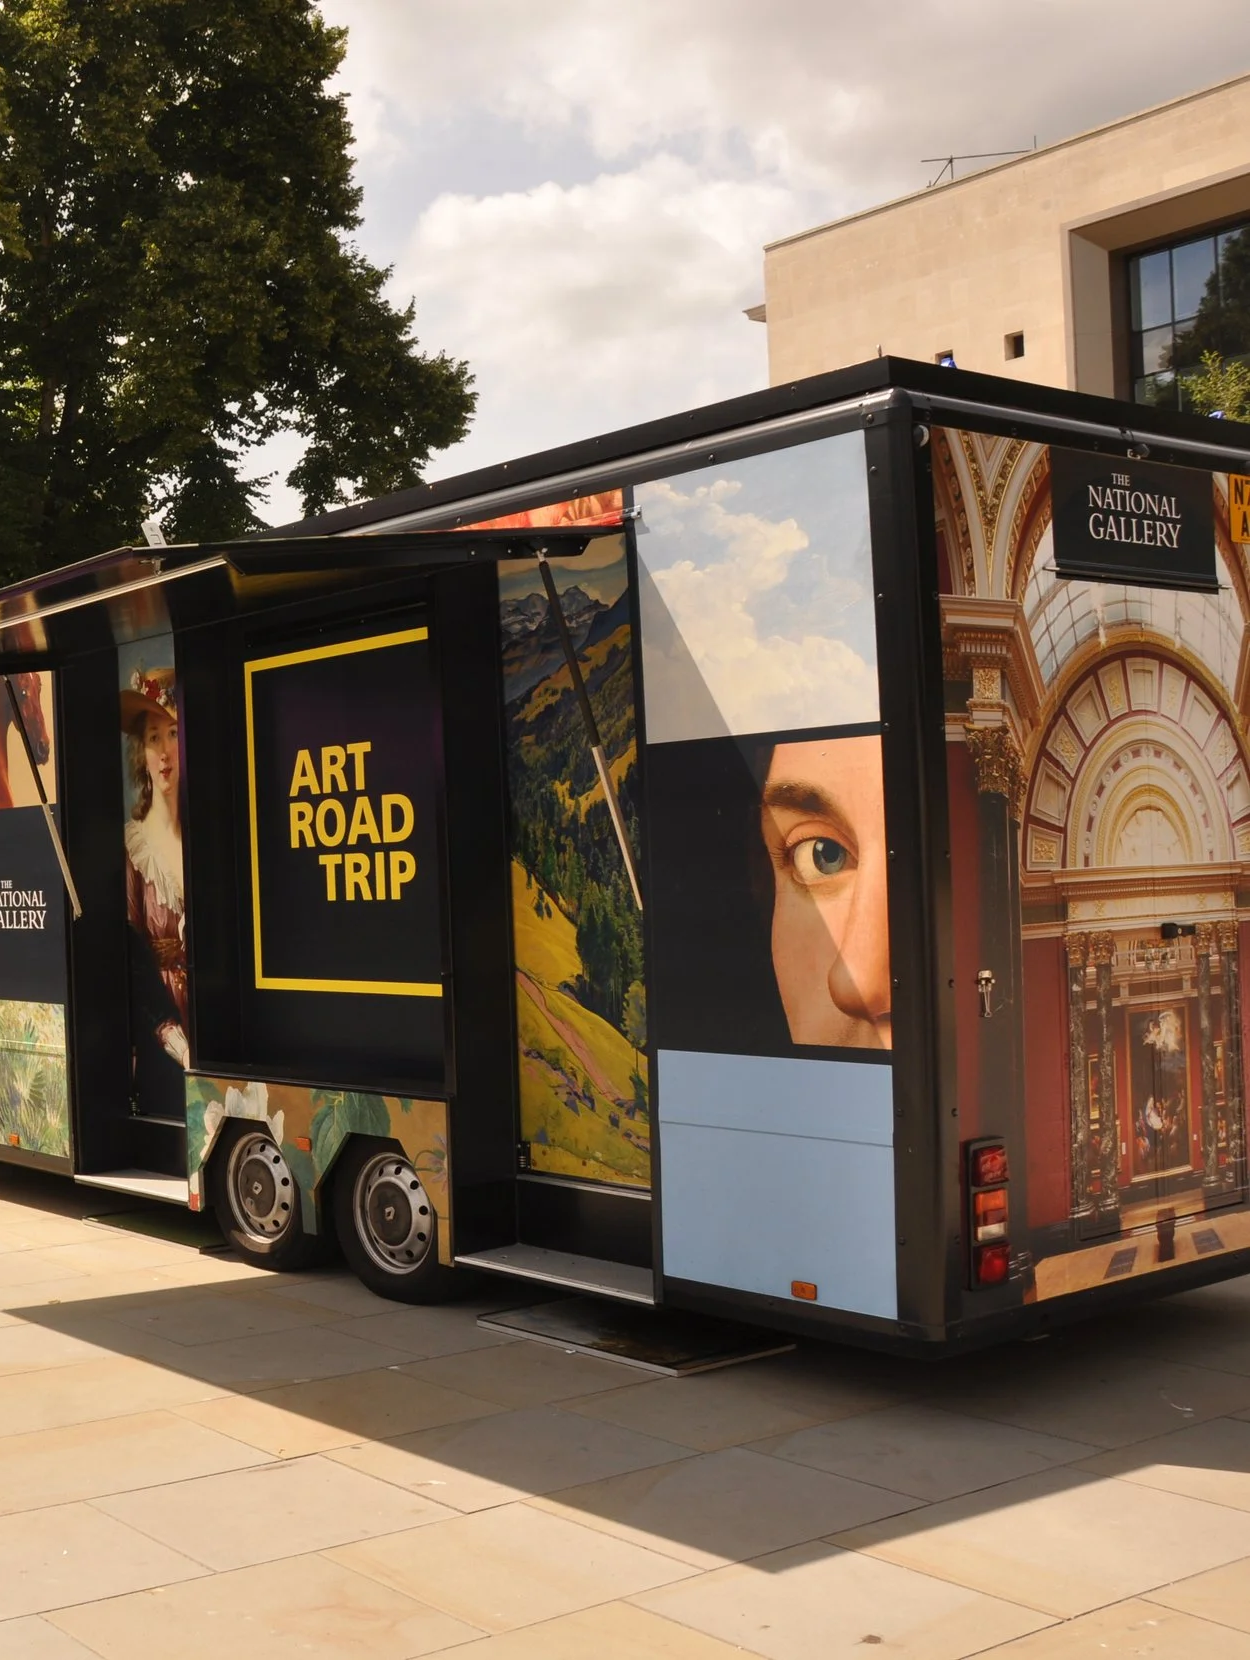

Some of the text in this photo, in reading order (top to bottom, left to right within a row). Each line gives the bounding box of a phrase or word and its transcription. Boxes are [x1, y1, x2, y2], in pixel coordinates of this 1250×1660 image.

[1111, 473, 1131, 487] THE
[1087, 485, 1181, 519] NATIONAL
[1089, 512, 1182, 549] GALLERY
[289, 741, 371, 797] ART
[289, 793, 415, 849] ROAD
[0, 880, 13, 889] THE
[318, 850, 417, 901] TRIP
